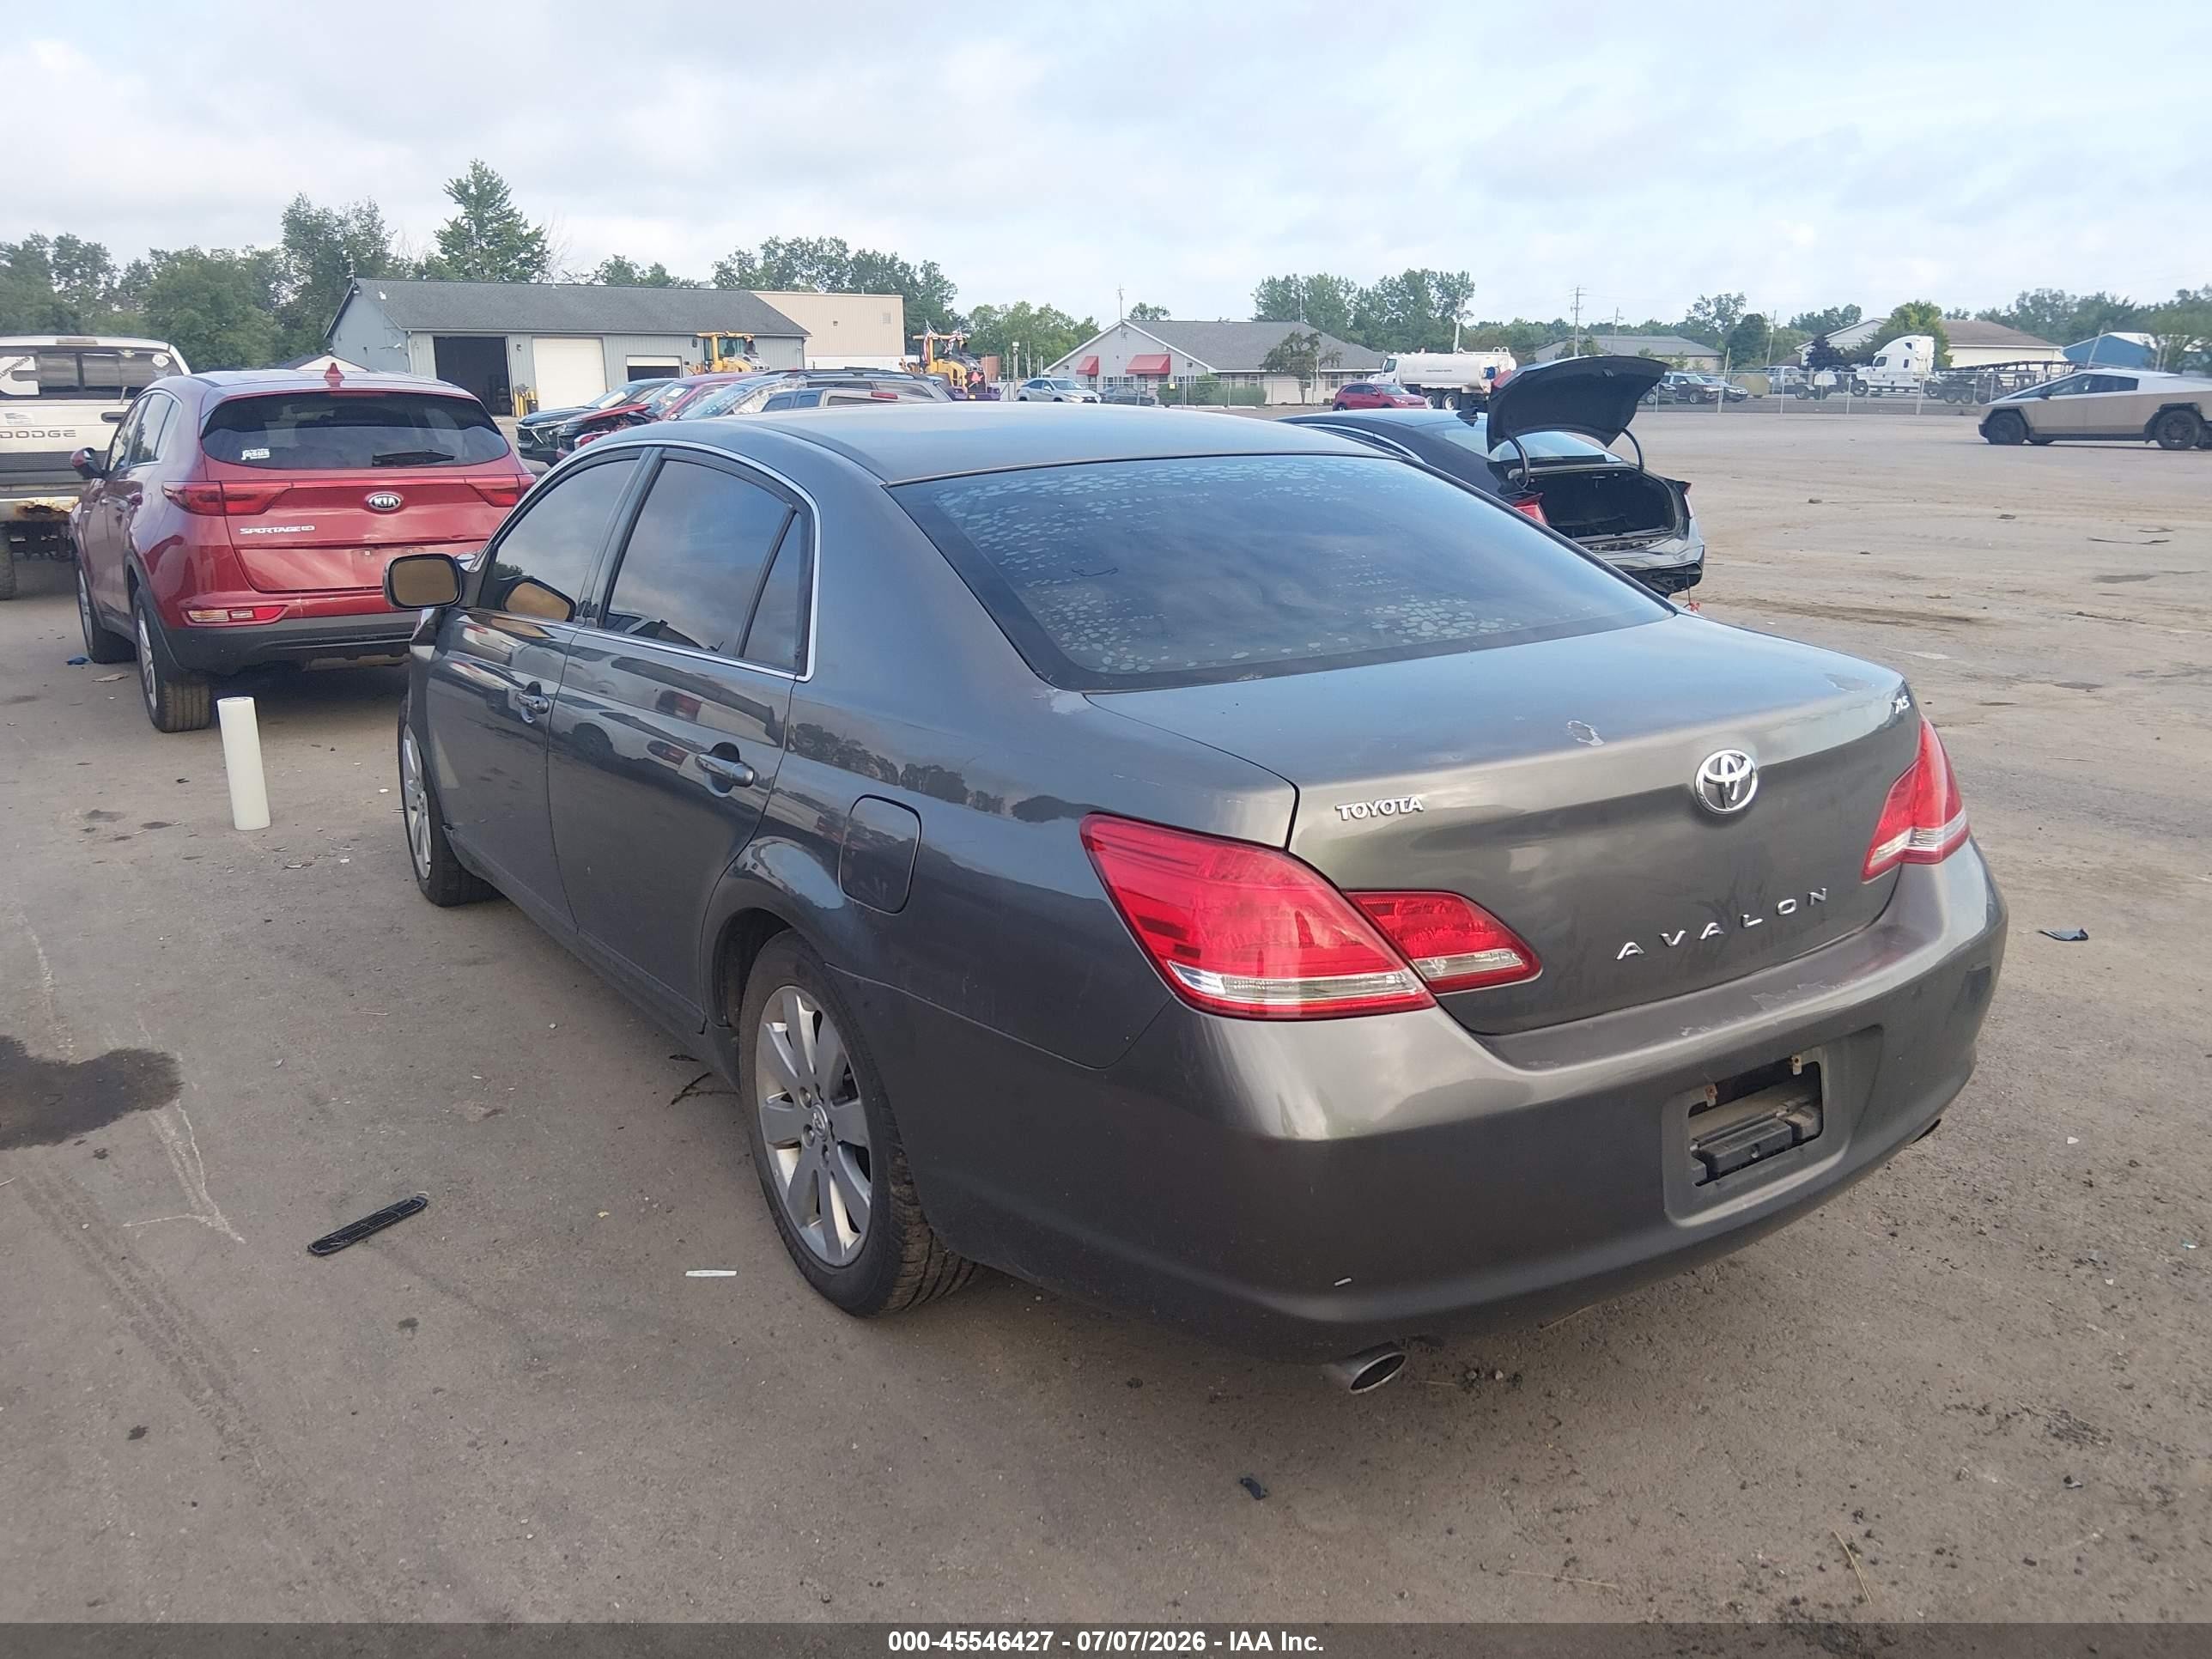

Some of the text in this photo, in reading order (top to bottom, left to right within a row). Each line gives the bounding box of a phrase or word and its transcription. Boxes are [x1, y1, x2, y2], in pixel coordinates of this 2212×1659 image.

[0, 430, 76, 439] DODGE
[373, 497, 396, 507] KIA
[240, 526, 301, 534] SPORTAGE
[1334, 797, 1424, 820] TOYOTA
[1615, 887, 1826, 960] AVALON
